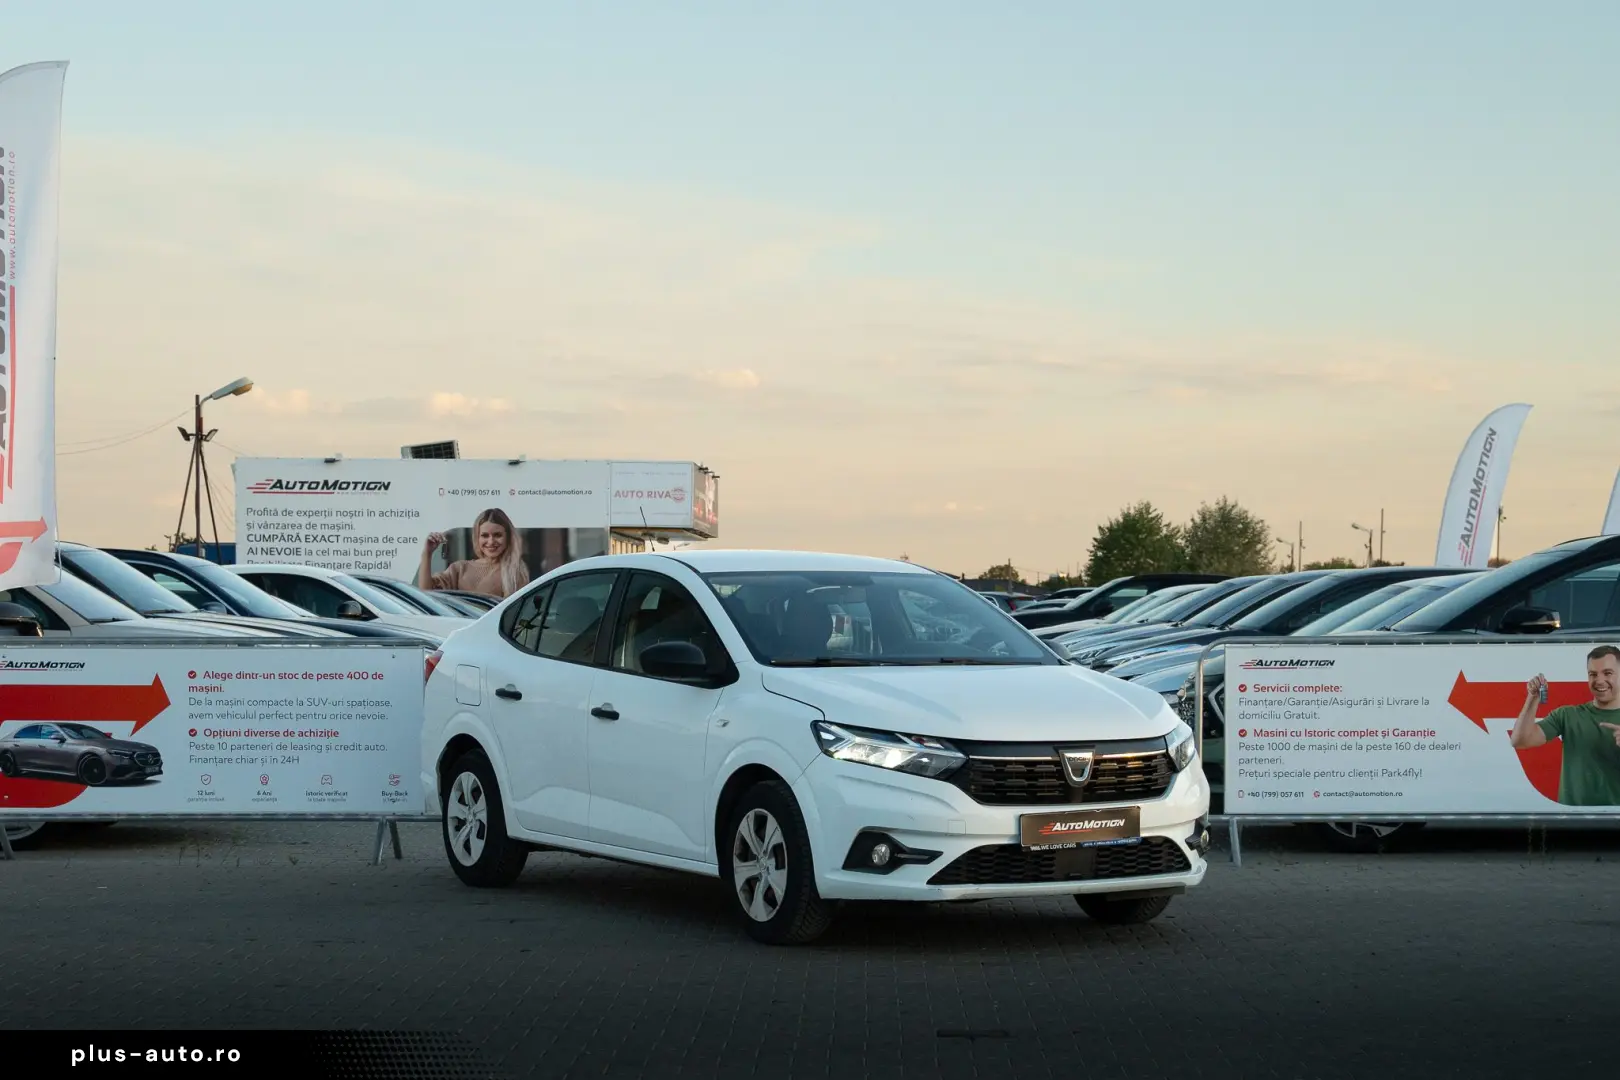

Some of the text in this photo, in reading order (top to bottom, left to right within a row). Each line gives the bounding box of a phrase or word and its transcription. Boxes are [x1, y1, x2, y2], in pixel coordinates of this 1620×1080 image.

[269, 479, 391, 490] AUTOMOTION
[1459, 427, 1497, 548] AUTOMOTION
[614, 490, 643, 498] AUTO
[647, 490, 671, 498] RIVA
[247, 507, 419, 519] Profită de experții noștri în achiziția
[246, 521, 355, 532] și vânzarea de mașini.
[247, 533, 302, 542] CUMPĂRĂ
[305, 534, 340, 543] EXACT
[343, 535, 379, 545] mașina
[382, 535, 394, 543] de
[247, 547, 397, 558] AI NEVOIE la cel mai bun preț!
[354, 560, 392, 570] Rapidă!
[203, 671, 233, 681] Alege
[236, 671, 275, 679] dintr-un
[301, 671, 314, 679] de
[317, 673, 344, 682] peste
[347, 671, 368, 680] 400
[371, 672, 383, 680] de
[189, 684, 224, 694] mașini.
[1254, 684, 1342, 694] Servicii complete:
[189, 697, 392, 709] De la mașini compacte la SUV-uri spațioase,
[1422, 697, 1429, 705] la
[216, 712, 256, 720] vehiculul
[259, 712, 293, 721] perfect
[296, 712, 327, 721] pentru
[330, 712, 352, 720] orice
[356, 712, 388, 720] nevoie.
[1239, 710, 1320, 719] domiciliu Gratuit.
[204, 729, 339, 739] Opțiuni diverse de achiziție
[1305, 729, 1335, 737] Istoric
[1338, 729, 1378, 739] complet
[1381, 728, 1389, 739] și
[1392, 728, 1435, 739] Garanție
[190, 742, 215, 750] Peste
[218, 742, 227, 750] 10
[231, 743, 273, 752] parteneri
[276, 742, 288, 750] de
[291, 742, 322, 753] leasing
[335, 743, 362, 751] credit
[1239, 742, 1460, 753] Peste 1000 de mașini de la peste 160 de dealeri
[190, 755, 233, 766] Finanțare
[236, 755, 258, 764] chiar
[281, 755, 299, 764] 24H
[1239, 756, 1284, 765] parteneri.
[1239, 768, 1422, 780] Prețuri speciale pentru clienții Park4fly!
[1262, 791, 1278, 799] (799)
[1052, 820, 1125, 831] AUTOMOTION
